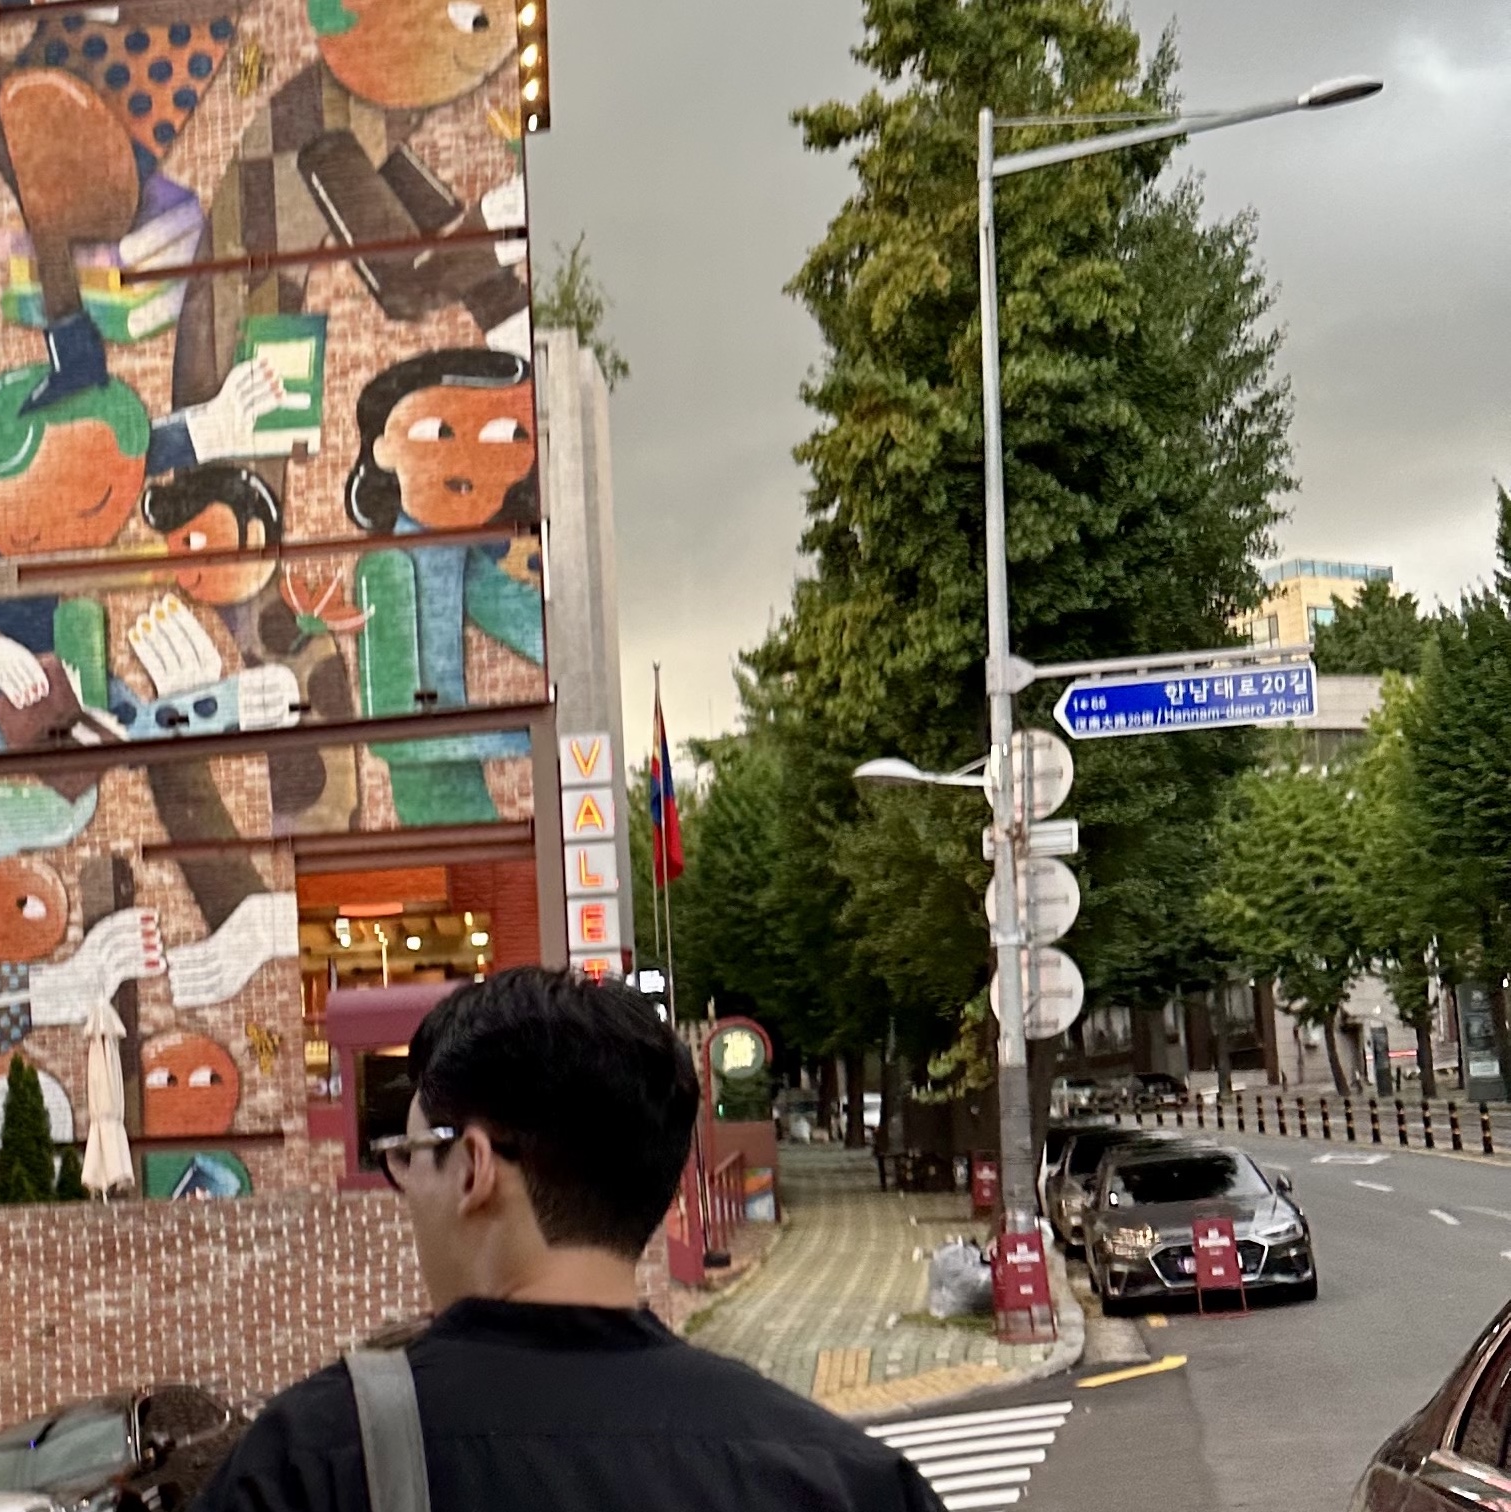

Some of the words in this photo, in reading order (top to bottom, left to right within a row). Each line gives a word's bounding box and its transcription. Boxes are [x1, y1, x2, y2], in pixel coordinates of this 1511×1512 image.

[1164, 668, 1308, 706] 한남대로20길
[1270, 697, 1309, 717] 20-gil
[571, 738, 609, 985] VALET
